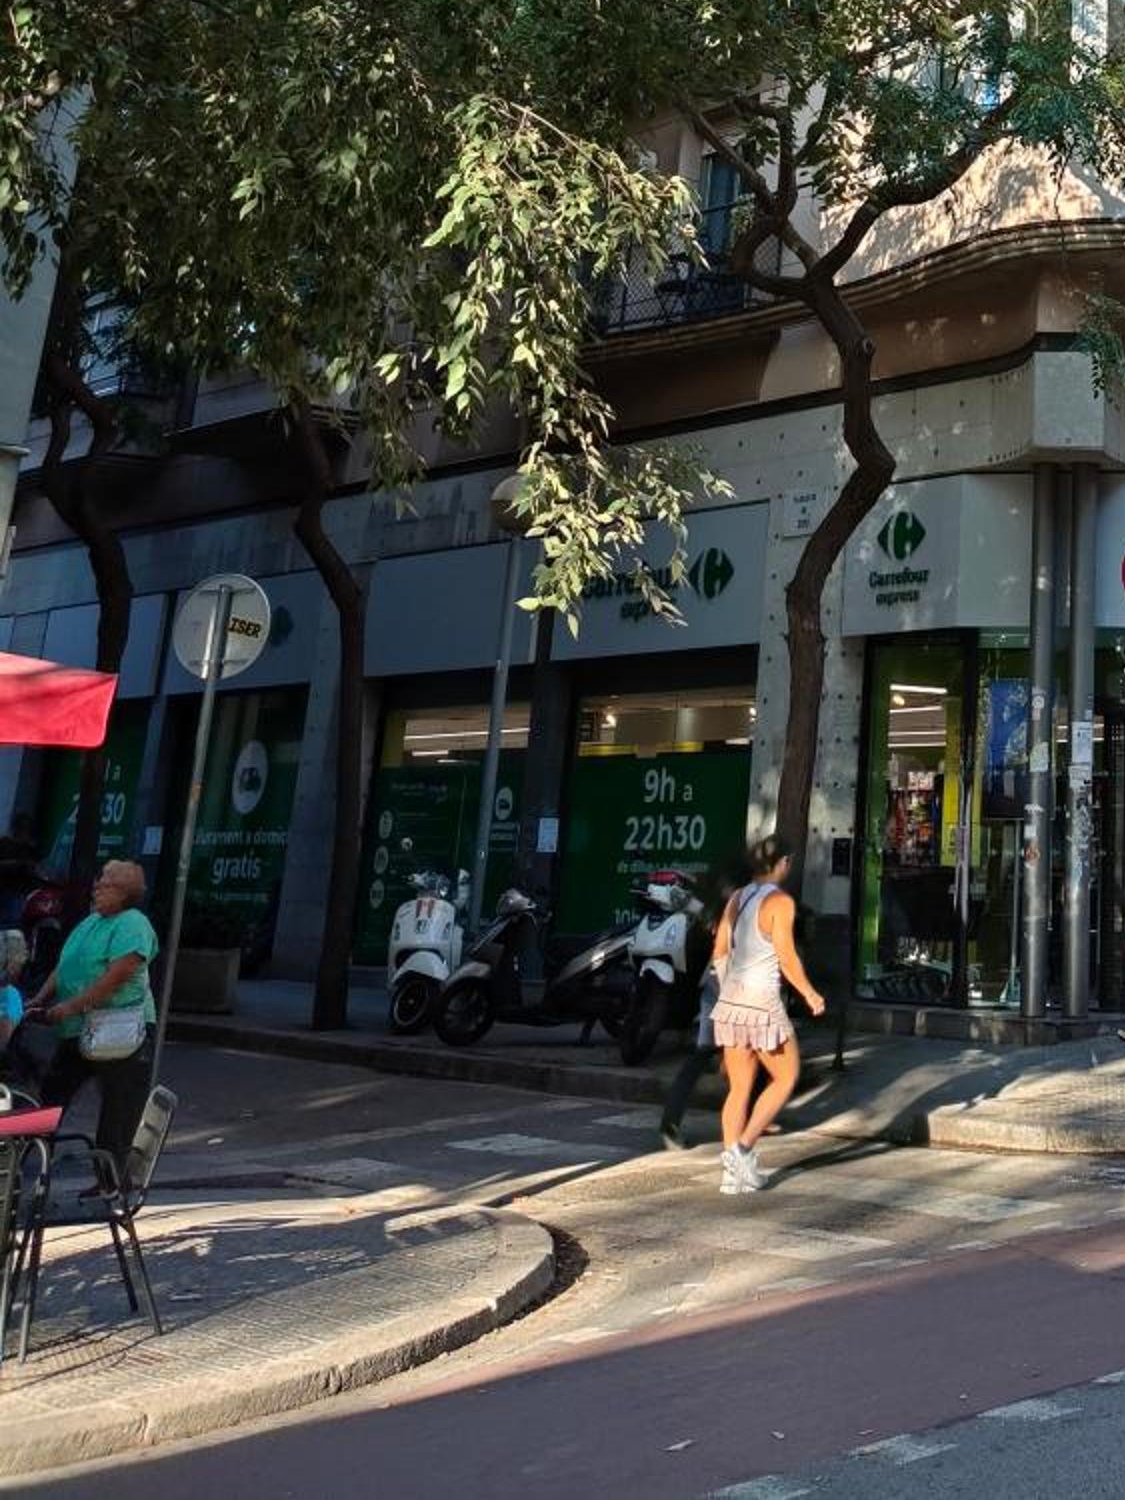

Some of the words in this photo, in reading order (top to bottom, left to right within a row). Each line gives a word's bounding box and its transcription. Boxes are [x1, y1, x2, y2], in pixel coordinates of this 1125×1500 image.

[869, 566, 930, 588] Carrefour
[644, 767, 676, 803] 9h
[683, 783, 694, 803] a
[623, 814, 707, 850] 22h30
[212, 848, 262, 884] gratis
